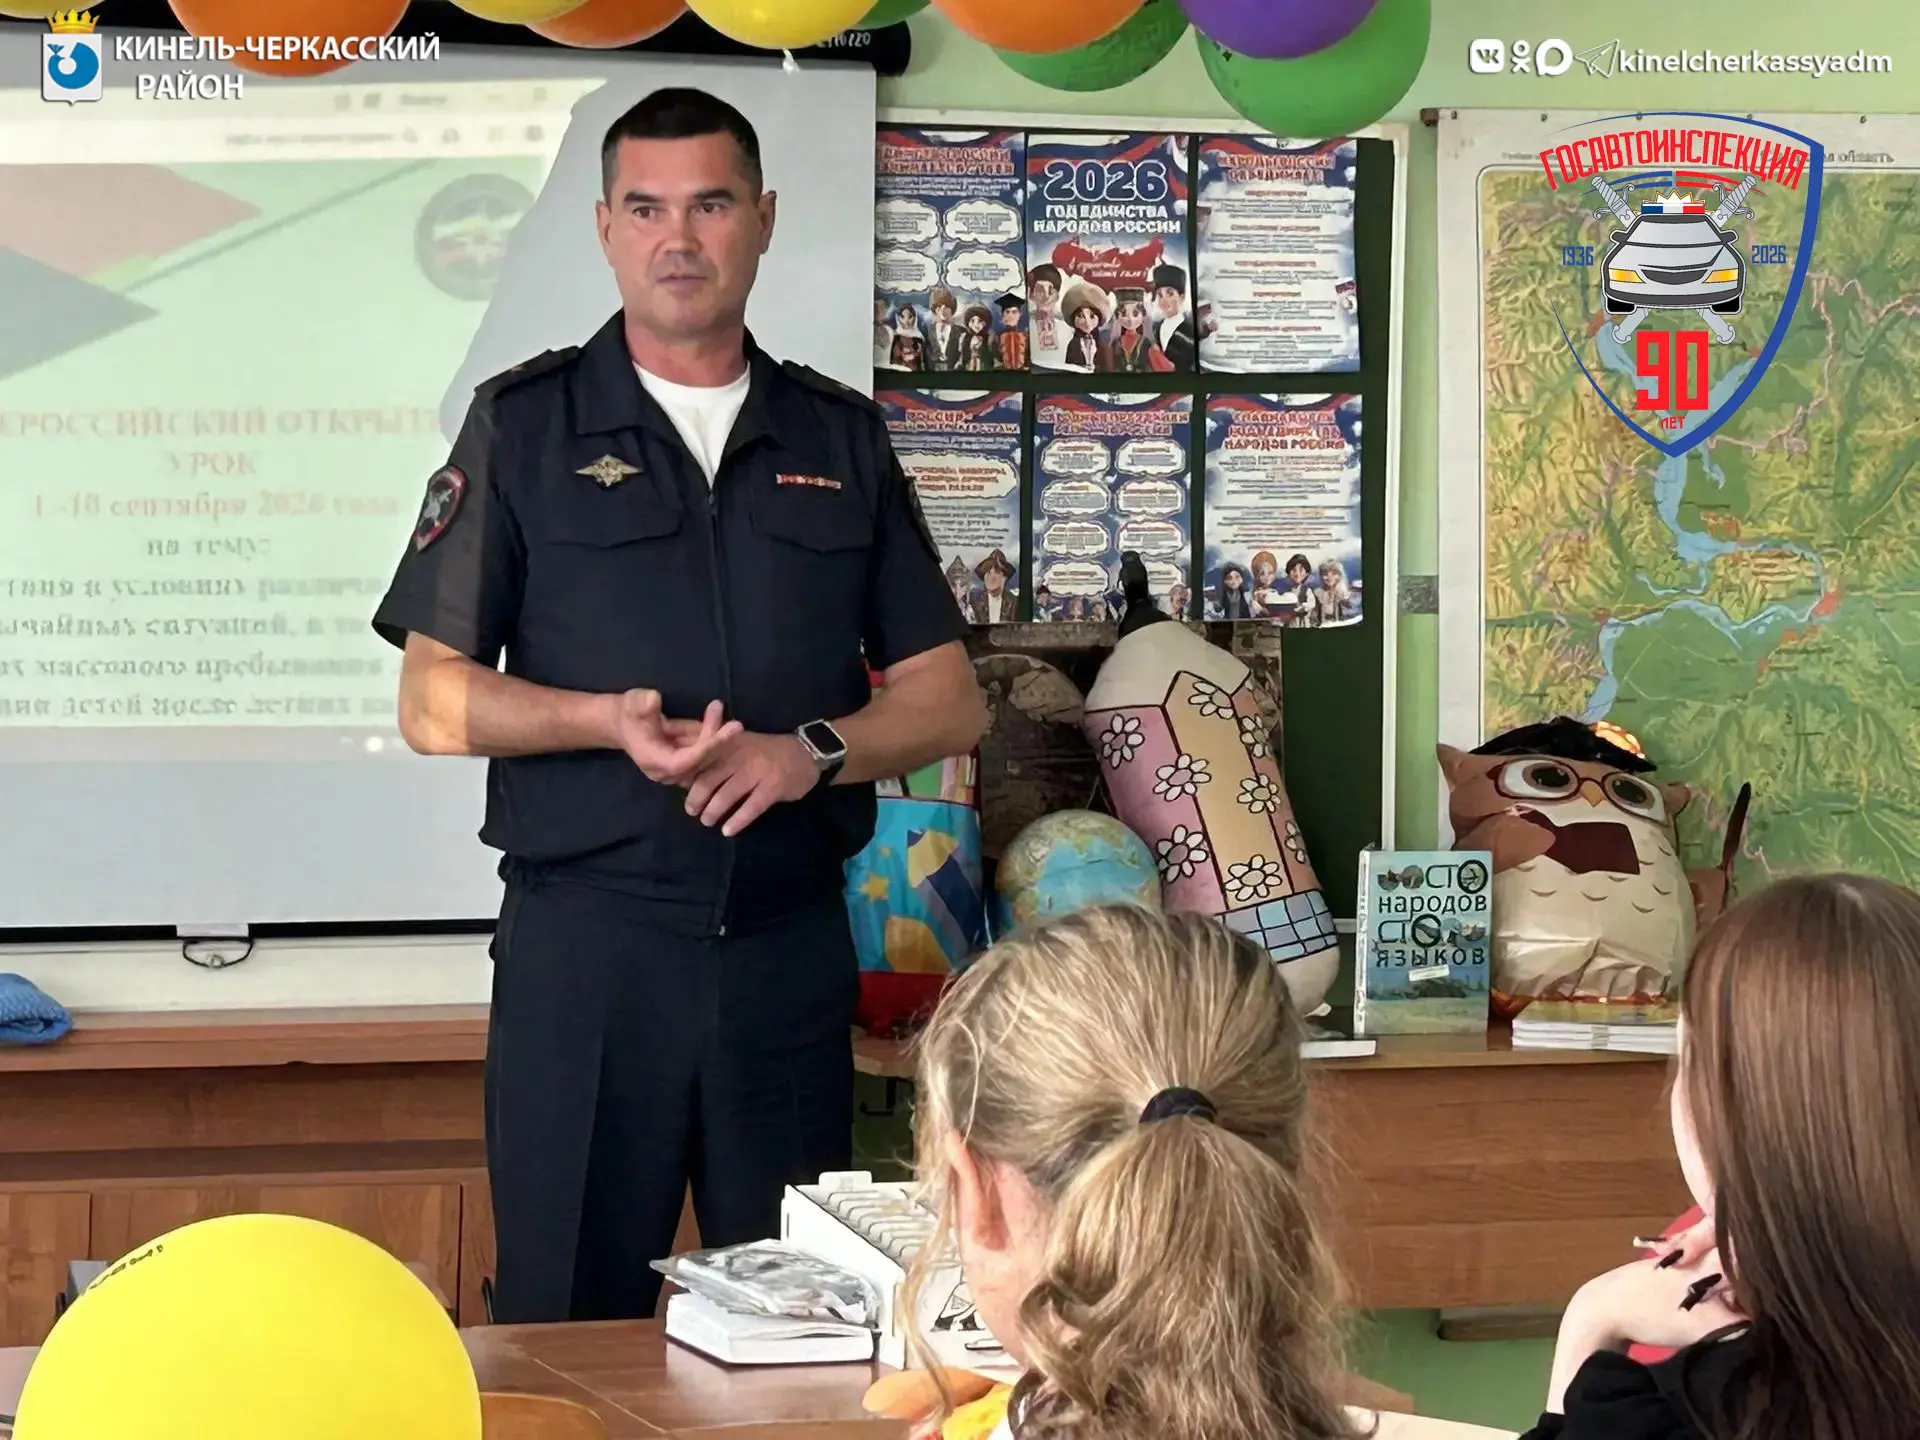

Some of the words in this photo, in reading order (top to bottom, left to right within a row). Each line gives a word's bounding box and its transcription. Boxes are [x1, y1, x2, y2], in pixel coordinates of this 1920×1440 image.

[1044, 159, 1168, 201] 2026
[1046, 204, 1078, 219] ГОД
[1080, 204, 1168, 219] ЕДИНСТВА
[1033, 220, 1112, 235] НАРОДОВ
[1114, 220, 1181, 234] РОССИИ
[1425, 859, 1489, 894] СТО
[1378, 894, 1488, 921] народов
[1375, 947, 1486, 968] языков
